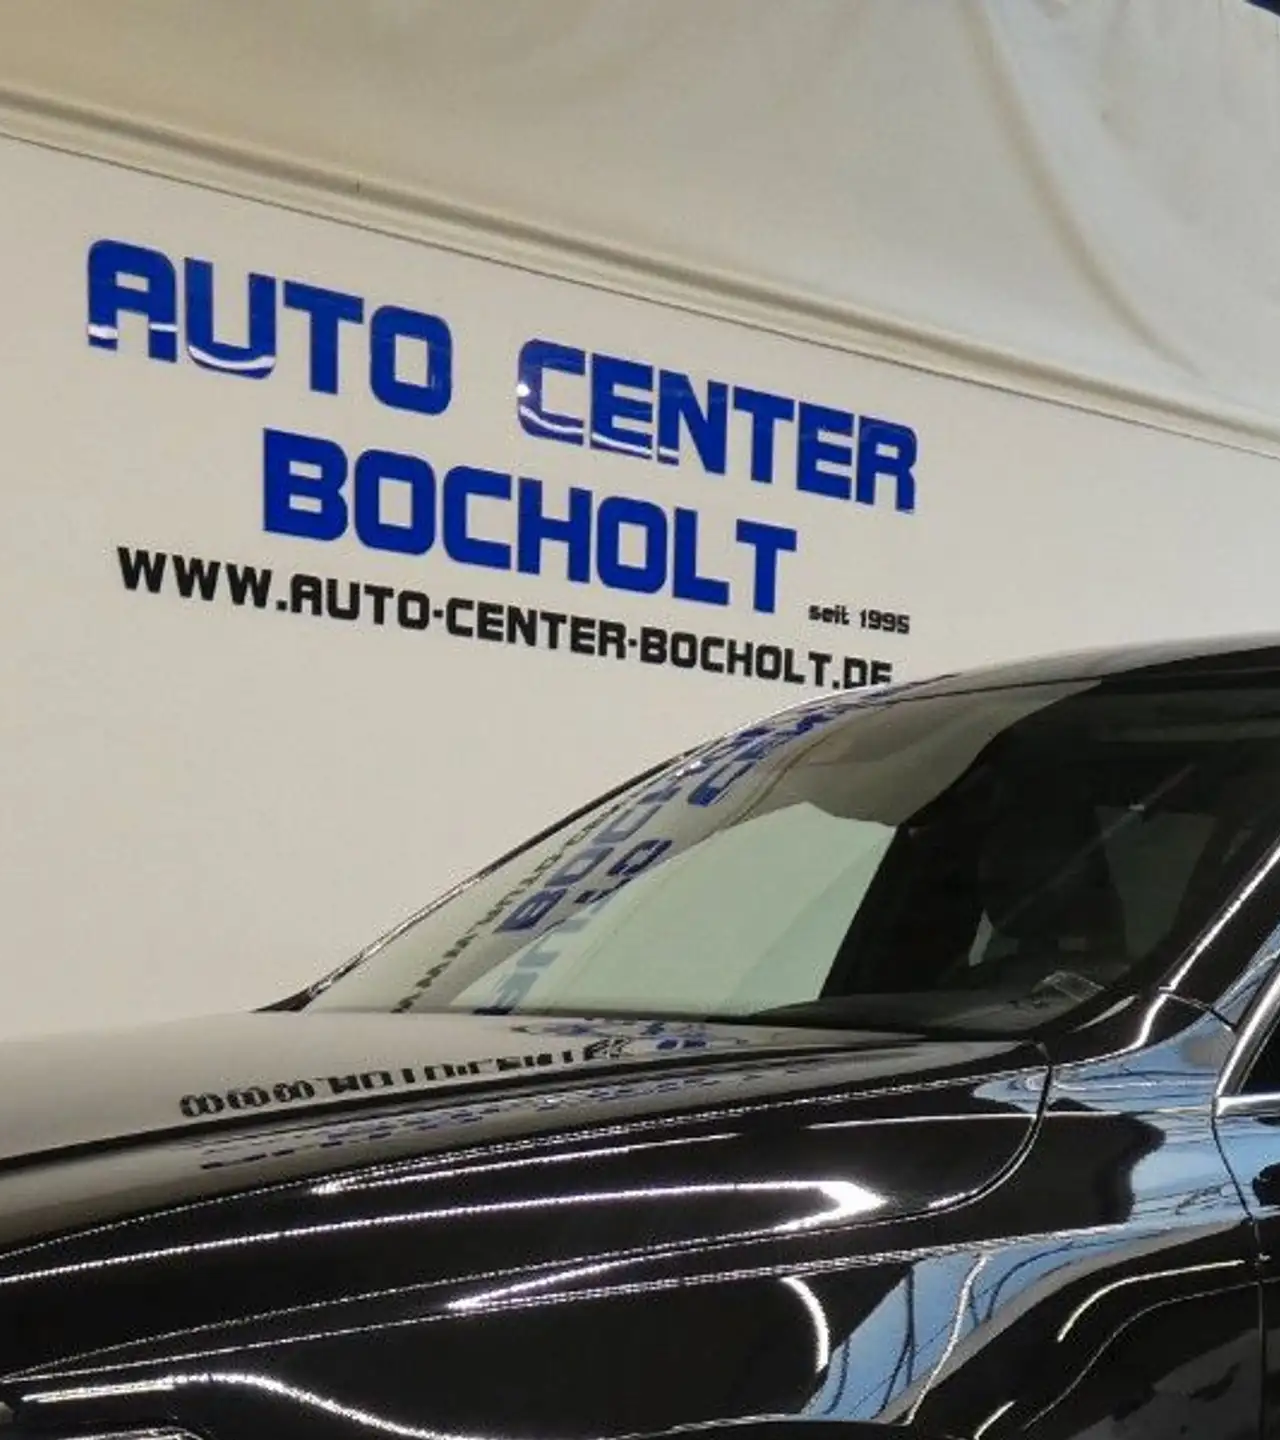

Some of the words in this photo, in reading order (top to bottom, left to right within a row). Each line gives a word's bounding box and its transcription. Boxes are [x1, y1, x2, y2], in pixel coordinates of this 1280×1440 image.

[86, 238, 454, 417] AUTO
[517, 338, 919, 514] CENTER
[261, 426, 799, 616] BOCHOLT
[116, 545, 894, 692] WWW.AUTO-CENTER-BOCHOLT.DE
[807, 603, 851, 627] seit
[859, 607, 911, 636] 1995
